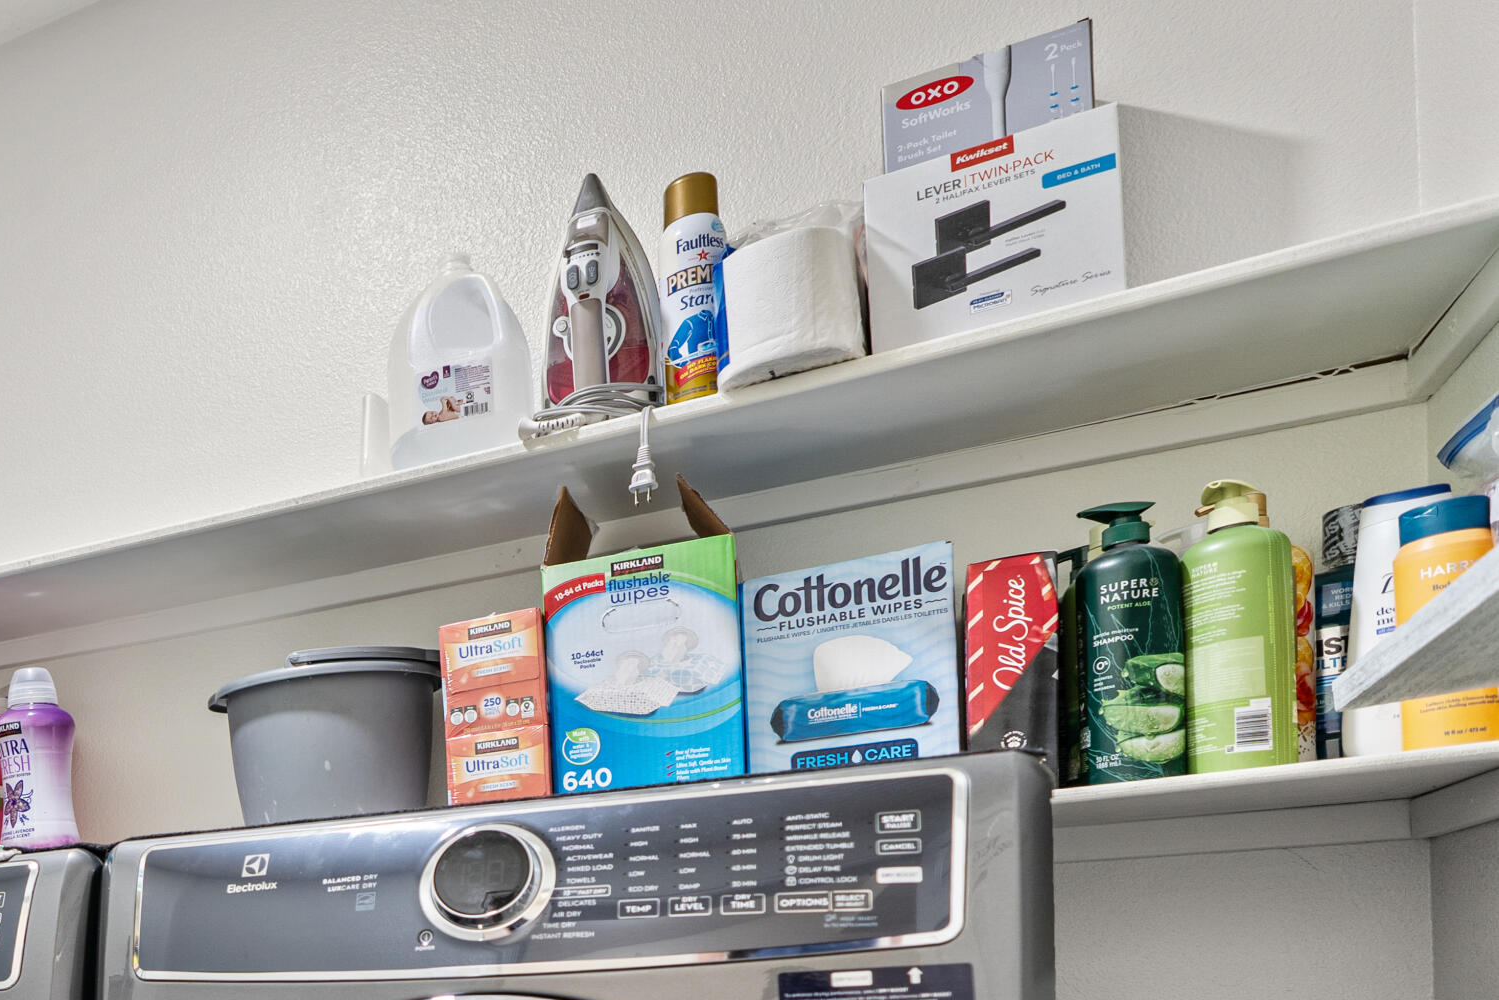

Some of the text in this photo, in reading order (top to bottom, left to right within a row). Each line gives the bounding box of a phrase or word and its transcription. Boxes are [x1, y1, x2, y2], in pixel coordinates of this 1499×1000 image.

[1044, 40, 1083, 61] 2 Pack
[910, 81, 959, 105] OXO
[901, 100, 971, 129] SoftWorks
[896, 129, 957, 153] 2-Pack Toilet
[897, 145, 942, 163] Brush Set
[955, 142, 1009, 165] Kwikset
[916, 149, 1055, 202] LEVER TWIN-PACK
[1056, 171, 1072, 181] BED
[1080, 162, 1101, 173] BATH
[942, 168, 1036, 202] HALIFAX LEVER SETS
[676, 233, 724, 254] Faultless
[668, 265, 713, 291] PREM
[1031, 270, 1112, 296] Signature Series
[680, 292, 714, 311] Star
[689, 363, 707, 377] DARK
[613, 556, 662, 571] KIRKLAND
[1192, 563, 1212, 572] SUPER
[1420, 560, 1475, 580] HARR
[1192, 568, 1218, 578] NATURE
[608, 571, 670, 592] flushable
[1100, 578, 1148, 594] SUPER
[554, 580, 604, 601] 10-64 ct Packs
[610, 585, 669, 604] wipes
[753, 556, 947, 622] Cottonelle
[1100, 587, 1159, 604] NATURE
[1107, 602, 1133, 611] POTENT
[778, 598, 923, 631] FLUSHABLE WIPES
[469, 621, 510, 635] KIRKLAND
[756, 633, 790, 644] FLUSHABLE
[791, 630, 811, 638] WIPES
[851, 619, 880, 629] JETABLES
[881, 616, 900, 624] DANS
[900, 613, 912, 621] LES
[913, 607, 949, 619] TOILETTES
[992, 574, 1033, 691] Old Spice
[1093, 626, 1139, 640] gentle moisture
[459, 636, 523, 658] UltraSoft
[1092, 634, 1134, 647] SHAMPOO
[571, 649, 604, 661] 10-64ct
[484, 697, 501, 707] 250
[807, 703, 858, 719] Cottonelle
[476, 738, 518, 750] KIRKLAND
[466, 753, 529, 773] UltraSoft
[796, 744, 912, 769] FRESH CARE
[2, 755, 31, 776] RESH
[563, 767, 612, 791] 640
[786, 812, 830, 821] ANTI-STATIC
[881, 814, 915, 824] START
[12, 828, 35, 836] LAVENDER
[548, 824, 585, 832] ALLERGEN
[630, 826, 660, 834] SANITIZE
[785, 823, 816, 831] PERFECT
[785, 831, 850, 841] WRINKLE RELEASE
[785, 844, 825, 852] EXTENDED
[881, 843, 916, 851] CANCEL
[566, 853, 614, 862] ACTIVEWEAR
[567, 863, 614, 872] MIXED LOAD
[798, 866, 822, 874] DELAY
[322, 873, 378, 885] BALANCED DRY
[798, 877, 835, 885] CONTROL
[226, 881, 278, 894] Electrolux
[327, 883, 360, 892] LUXCARE
[557, 899, 596, 907] DELICATES
[730, 900, 756, 909] TIME
[779, 897, 830, 908] OPTIONS
[835, 894, 866, 902] SELECT
[566, 910, 582, 918] DRY
[625, 905, 652, 913] TEMP
[674, 903, 705, 911] LEVEL
[563, 931, 595, 939] REFRESH
